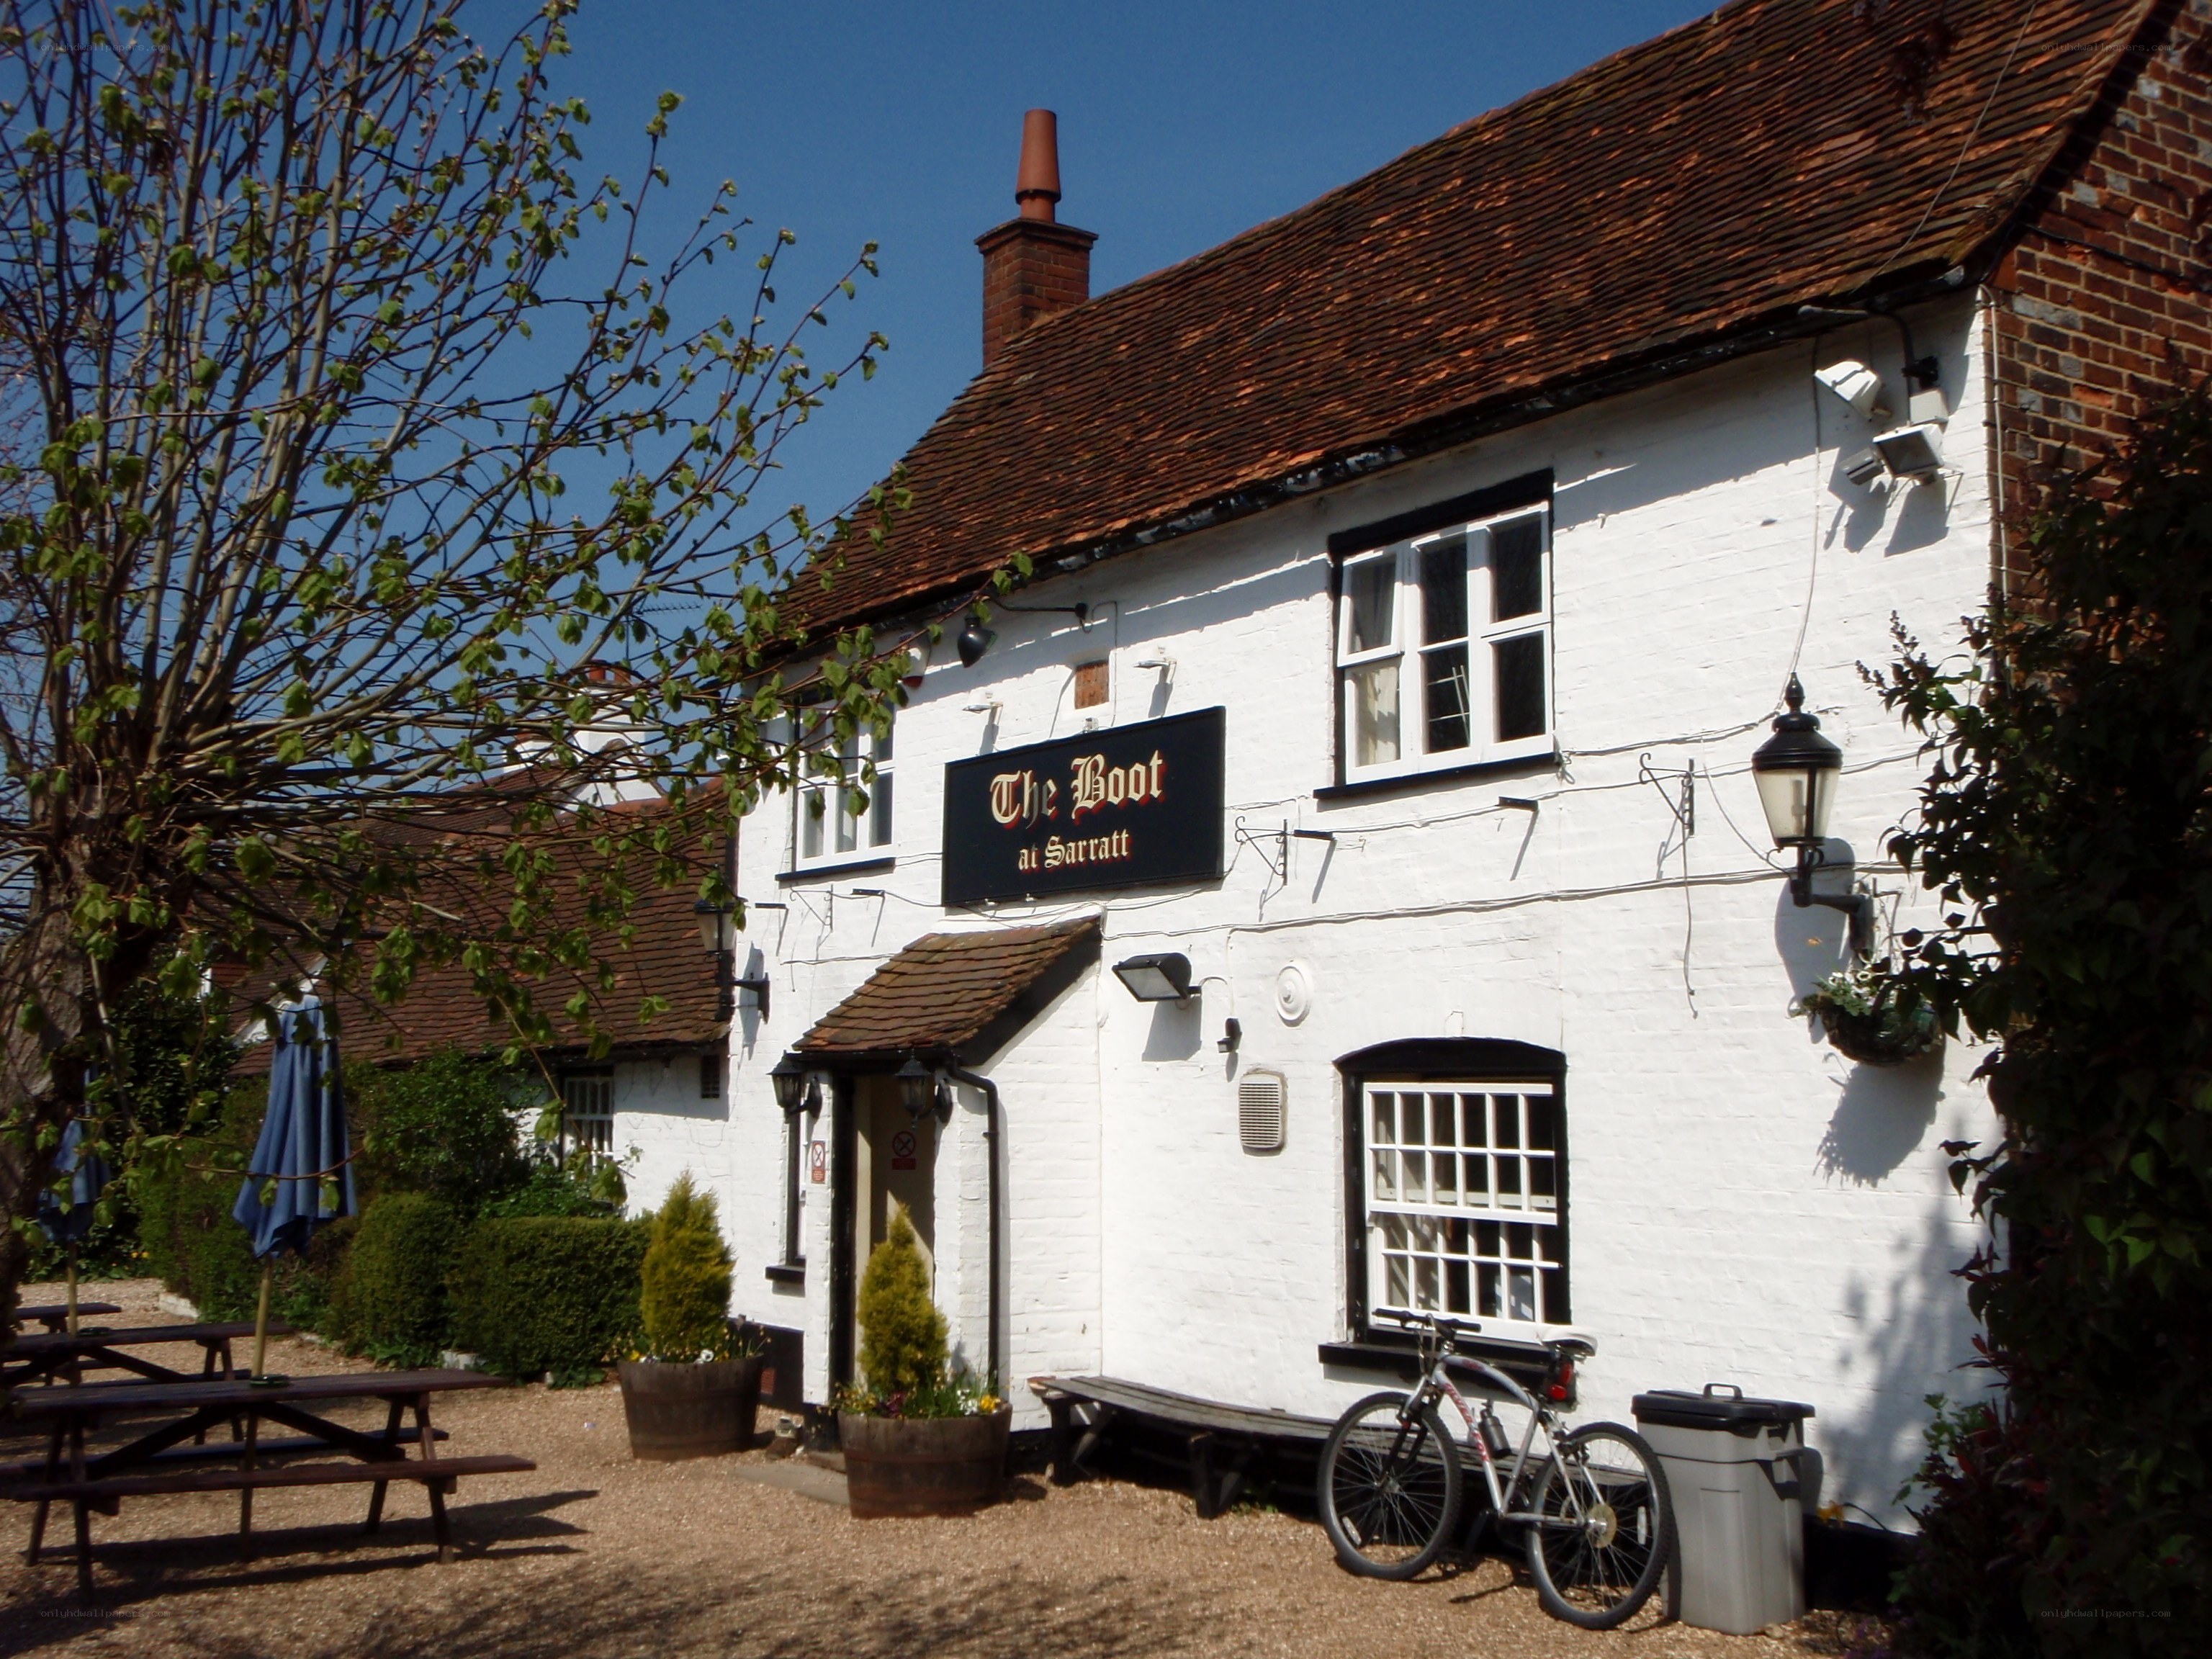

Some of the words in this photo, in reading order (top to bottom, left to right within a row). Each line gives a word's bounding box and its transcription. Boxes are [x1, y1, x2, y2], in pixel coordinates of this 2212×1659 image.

[989, 770, 1059, 829] The
[1071, 750, 1164, 822] Boot
[1018, 843, 1040, 871] at
[1045, 829, 1131, 869] Sarratt
